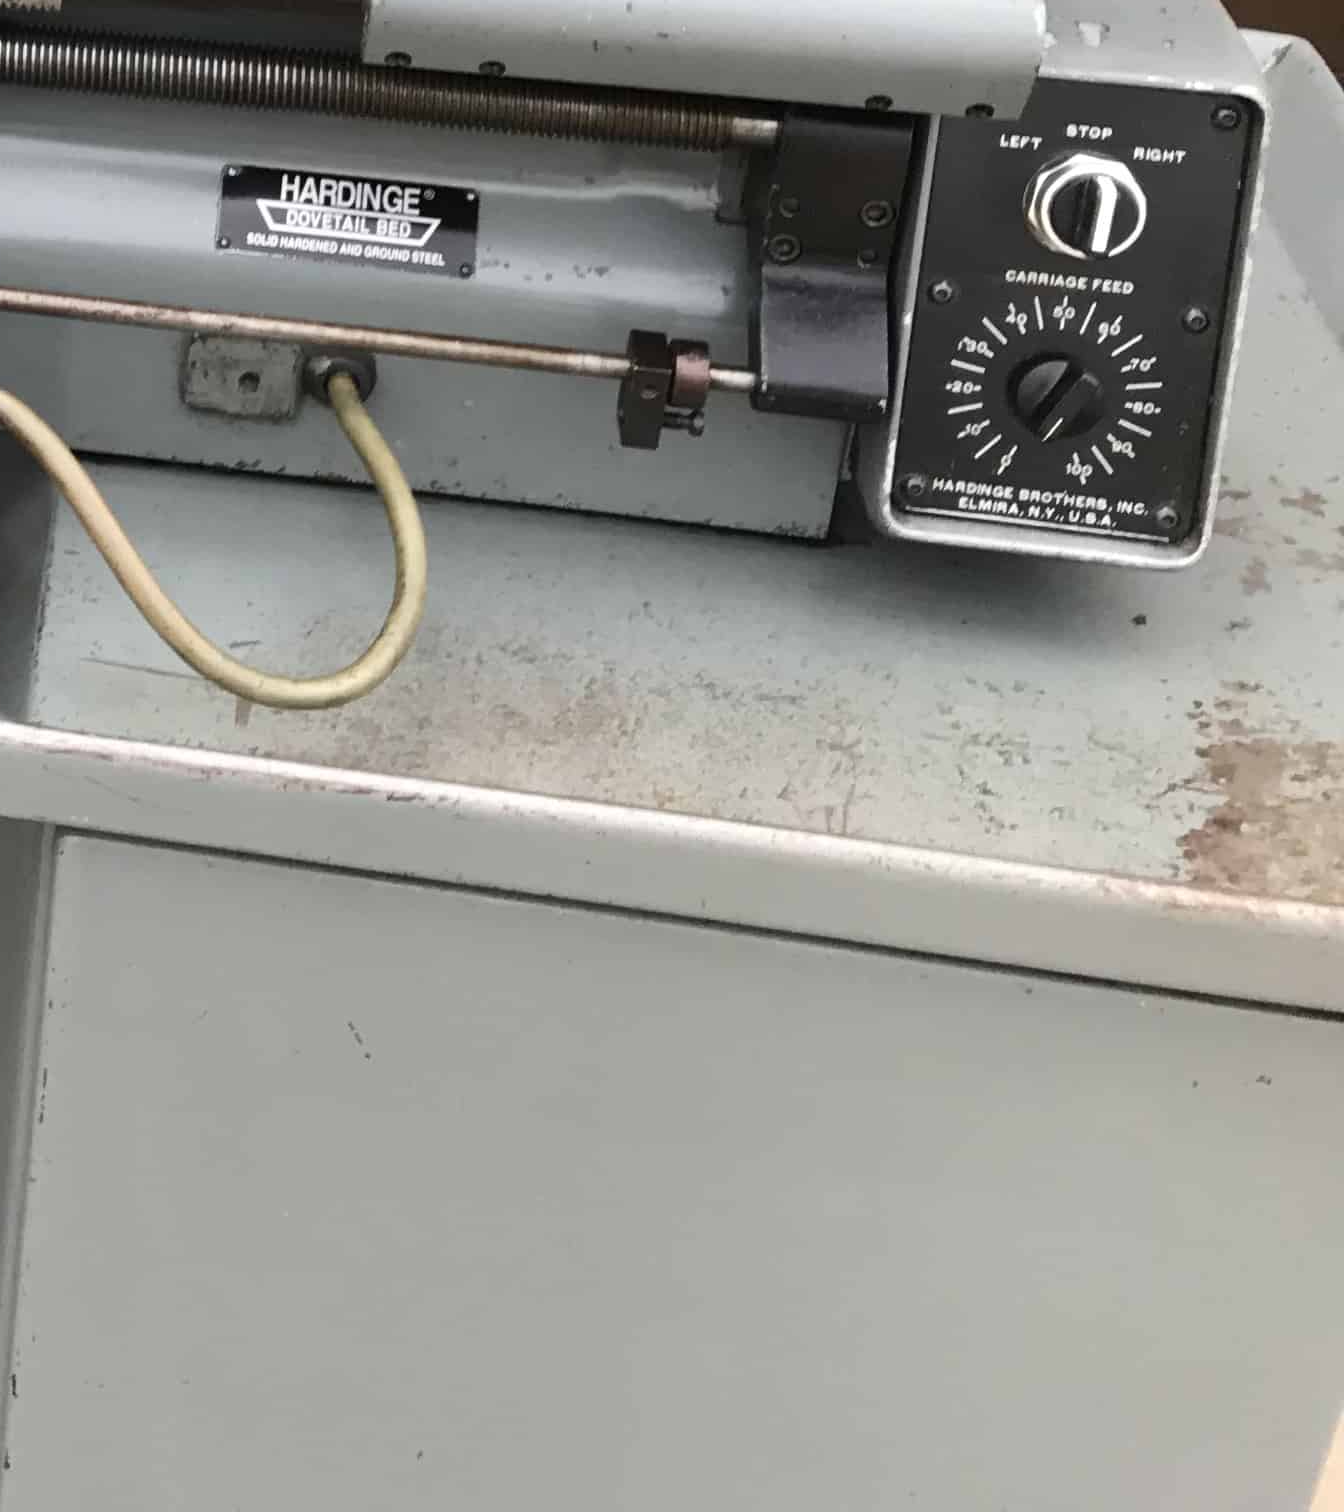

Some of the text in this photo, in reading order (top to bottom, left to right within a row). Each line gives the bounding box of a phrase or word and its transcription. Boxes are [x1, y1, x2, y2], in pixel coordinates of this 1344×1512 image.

[999, 133, 1043, 151] LEFT
[1066, 123, 1113, 142] STOP
[1133, 146, 1187, 165] RIGHT
[280, 173, 421, 216] HARDINGE
[286, 208, 412, 239] DOVETAIL BED
[246, 231, 446, 267] SOLID HARDENED AND GROUND STEEL
[1005, 269, 1135, 295] CARRIAGE FEED
[951, 380, 974, 394] 20
[932, 476, 1014, 500] HARDINGE
[1018, 488, 1113, 513] BROTHERS,
[958, 496, 1025, 518] ELMIRA,
[1068, 510, 1118, 529] U.S.A.
